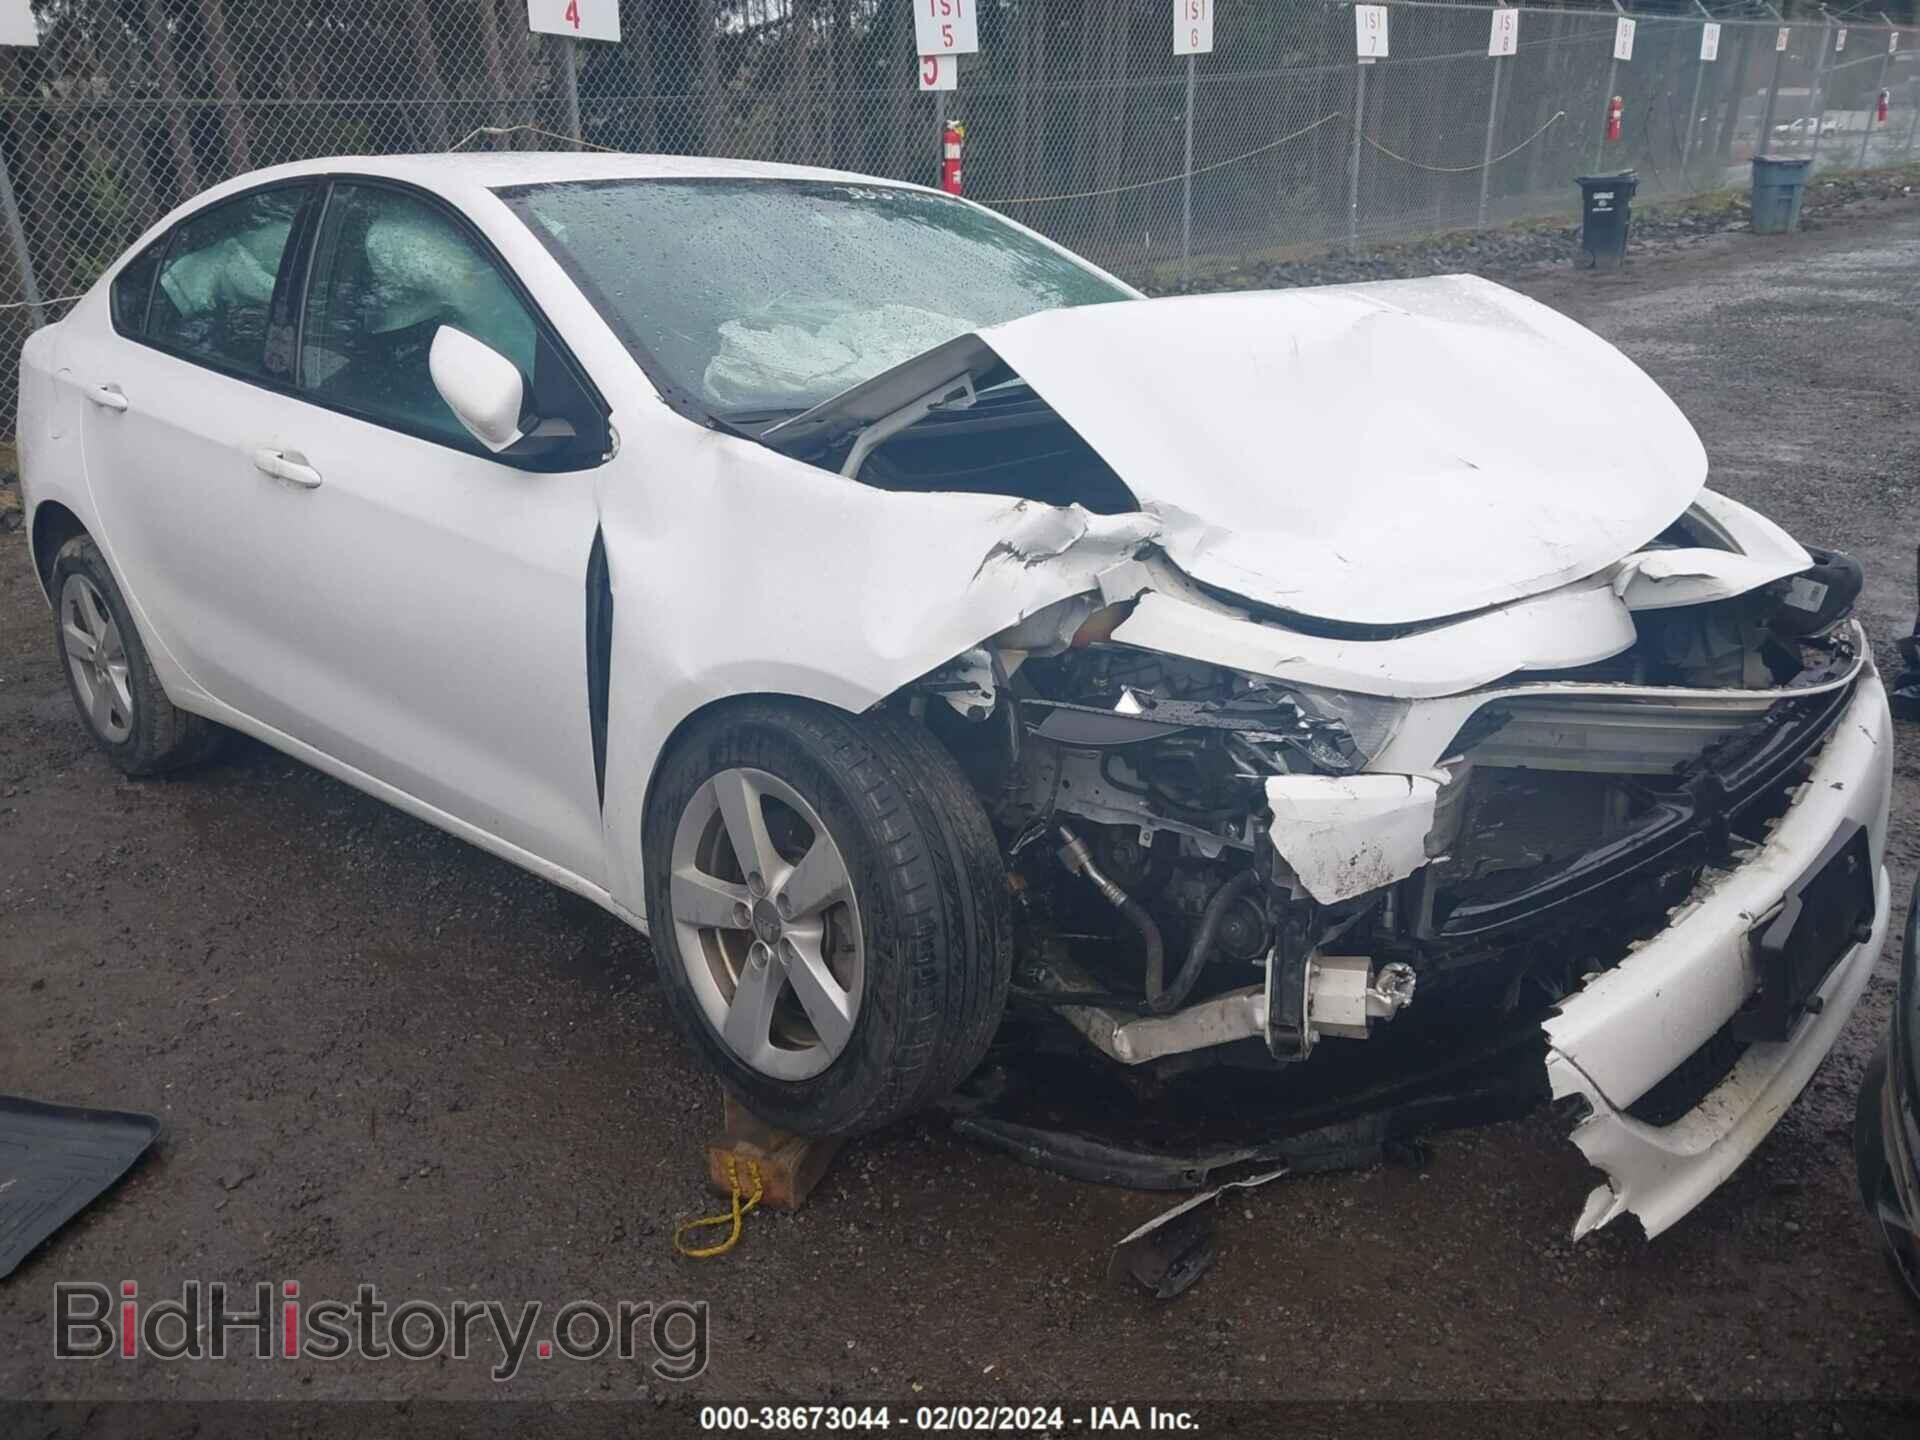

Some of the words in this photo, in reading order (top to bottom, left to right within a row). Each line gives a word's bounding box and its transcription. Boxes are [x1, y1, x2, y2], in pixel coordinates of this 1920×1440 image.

[565, 0, 580, 29] 4
[942, 24, 953, 48] 5
[1371, 35, 1377, 54] 7
